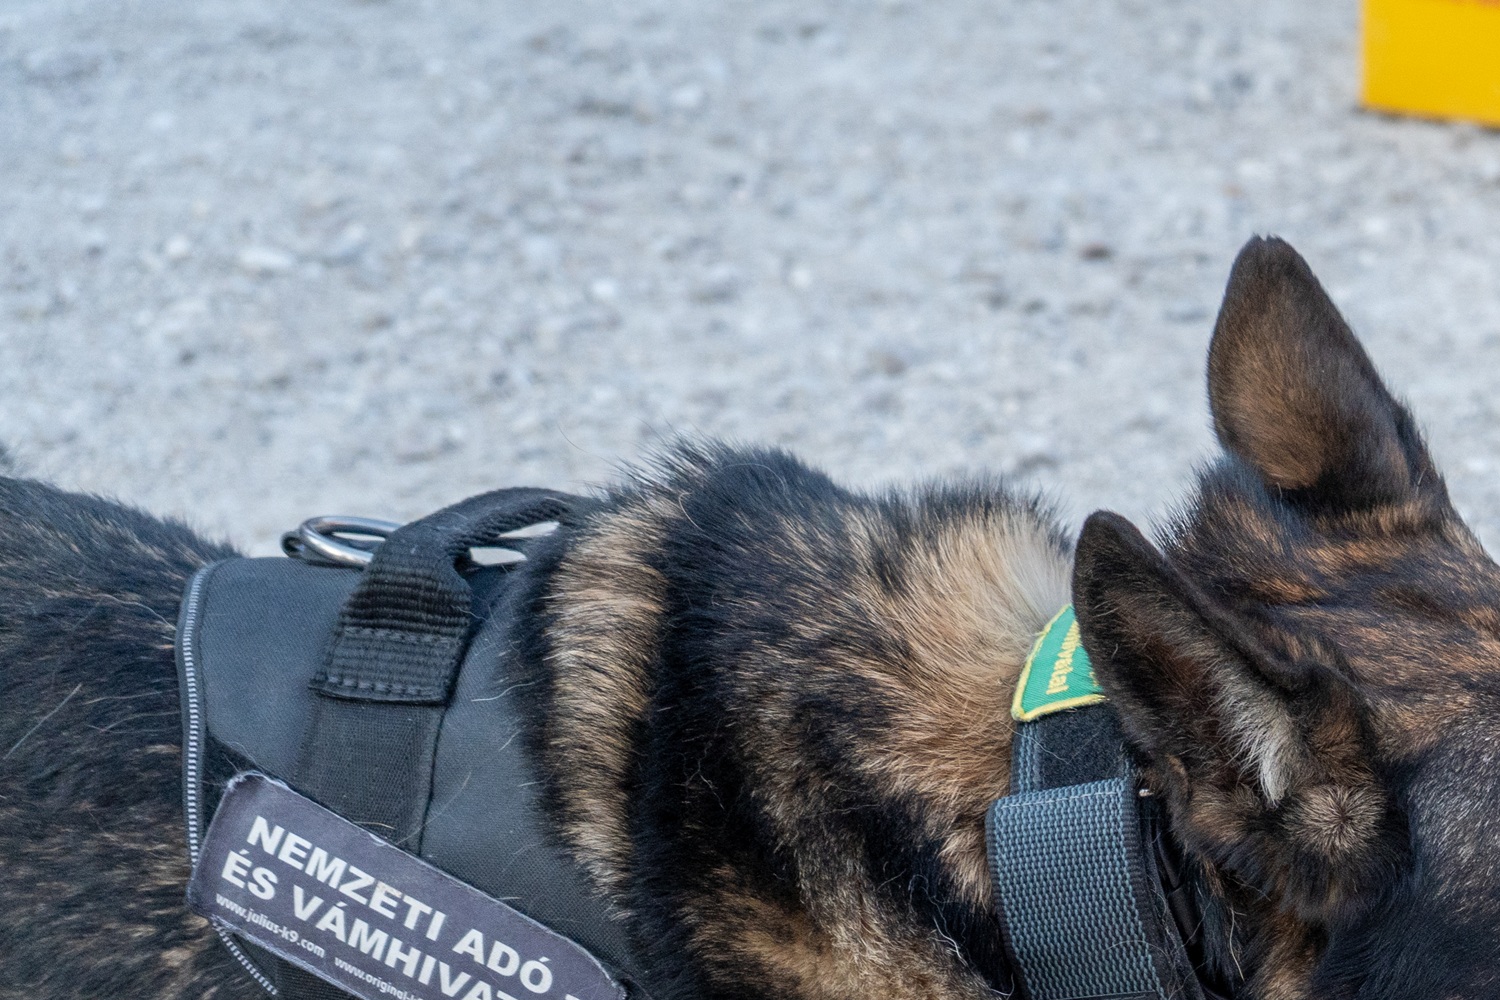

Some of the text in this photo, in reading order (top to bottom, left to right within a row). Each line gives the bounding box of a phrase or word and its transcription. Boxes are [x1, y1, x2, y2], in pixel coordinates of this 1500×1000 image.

[220, 849, 279, 901] ÉS
[246, 815, 448, 941] NEMZETI
[452, 927, 555, 995] ADÓ
[215, 892, 326, 959] www.julius-k9.com
